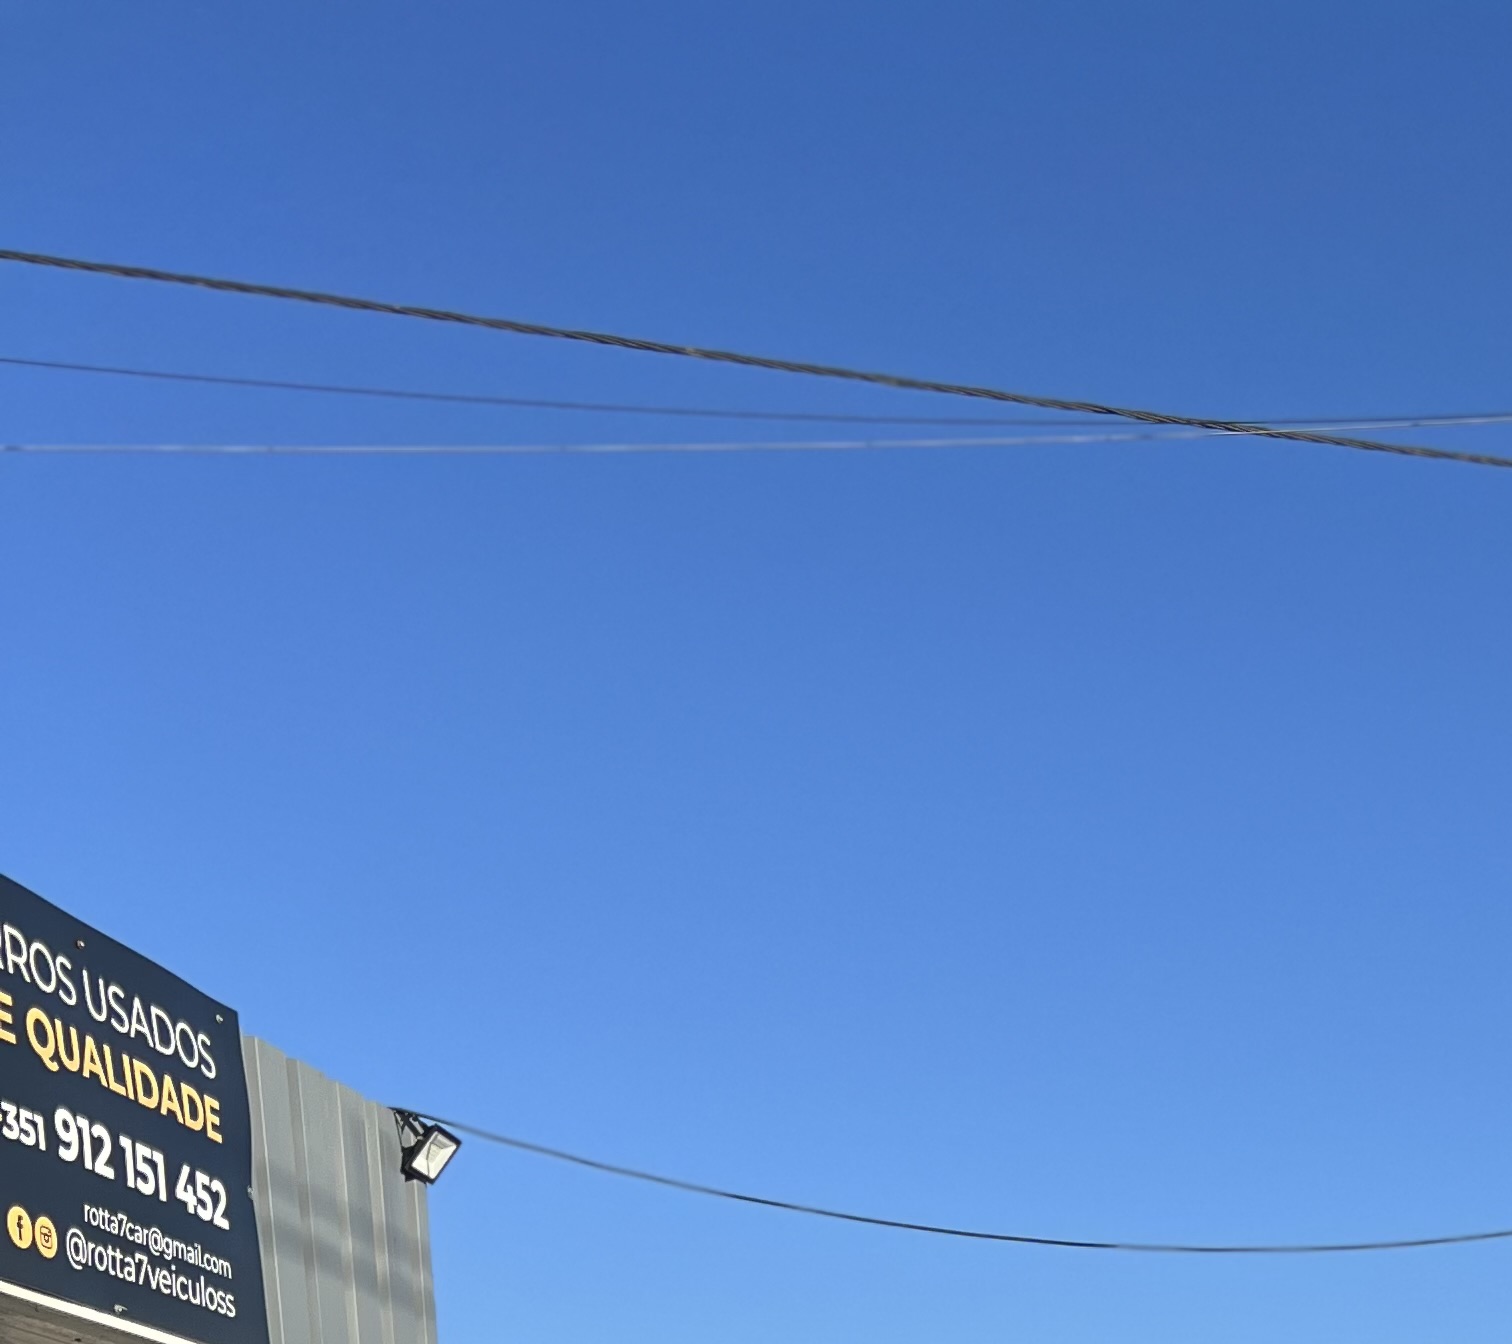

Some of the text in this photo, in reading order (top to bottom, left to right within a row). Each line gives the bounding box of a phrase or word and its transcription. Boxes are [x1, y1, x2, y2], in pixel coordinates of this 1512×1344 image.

[0, 922, 217, 1080] ROS USADOS
[26, 1007, 223, 1144] QUALIDADE
[0, 1101, 230, 1231] 351 912 151 452
[65, 1227, 237, 1318] @rotta7veiculoss
[83, 1203, 233, 1279] rotta7car@gmail.com
